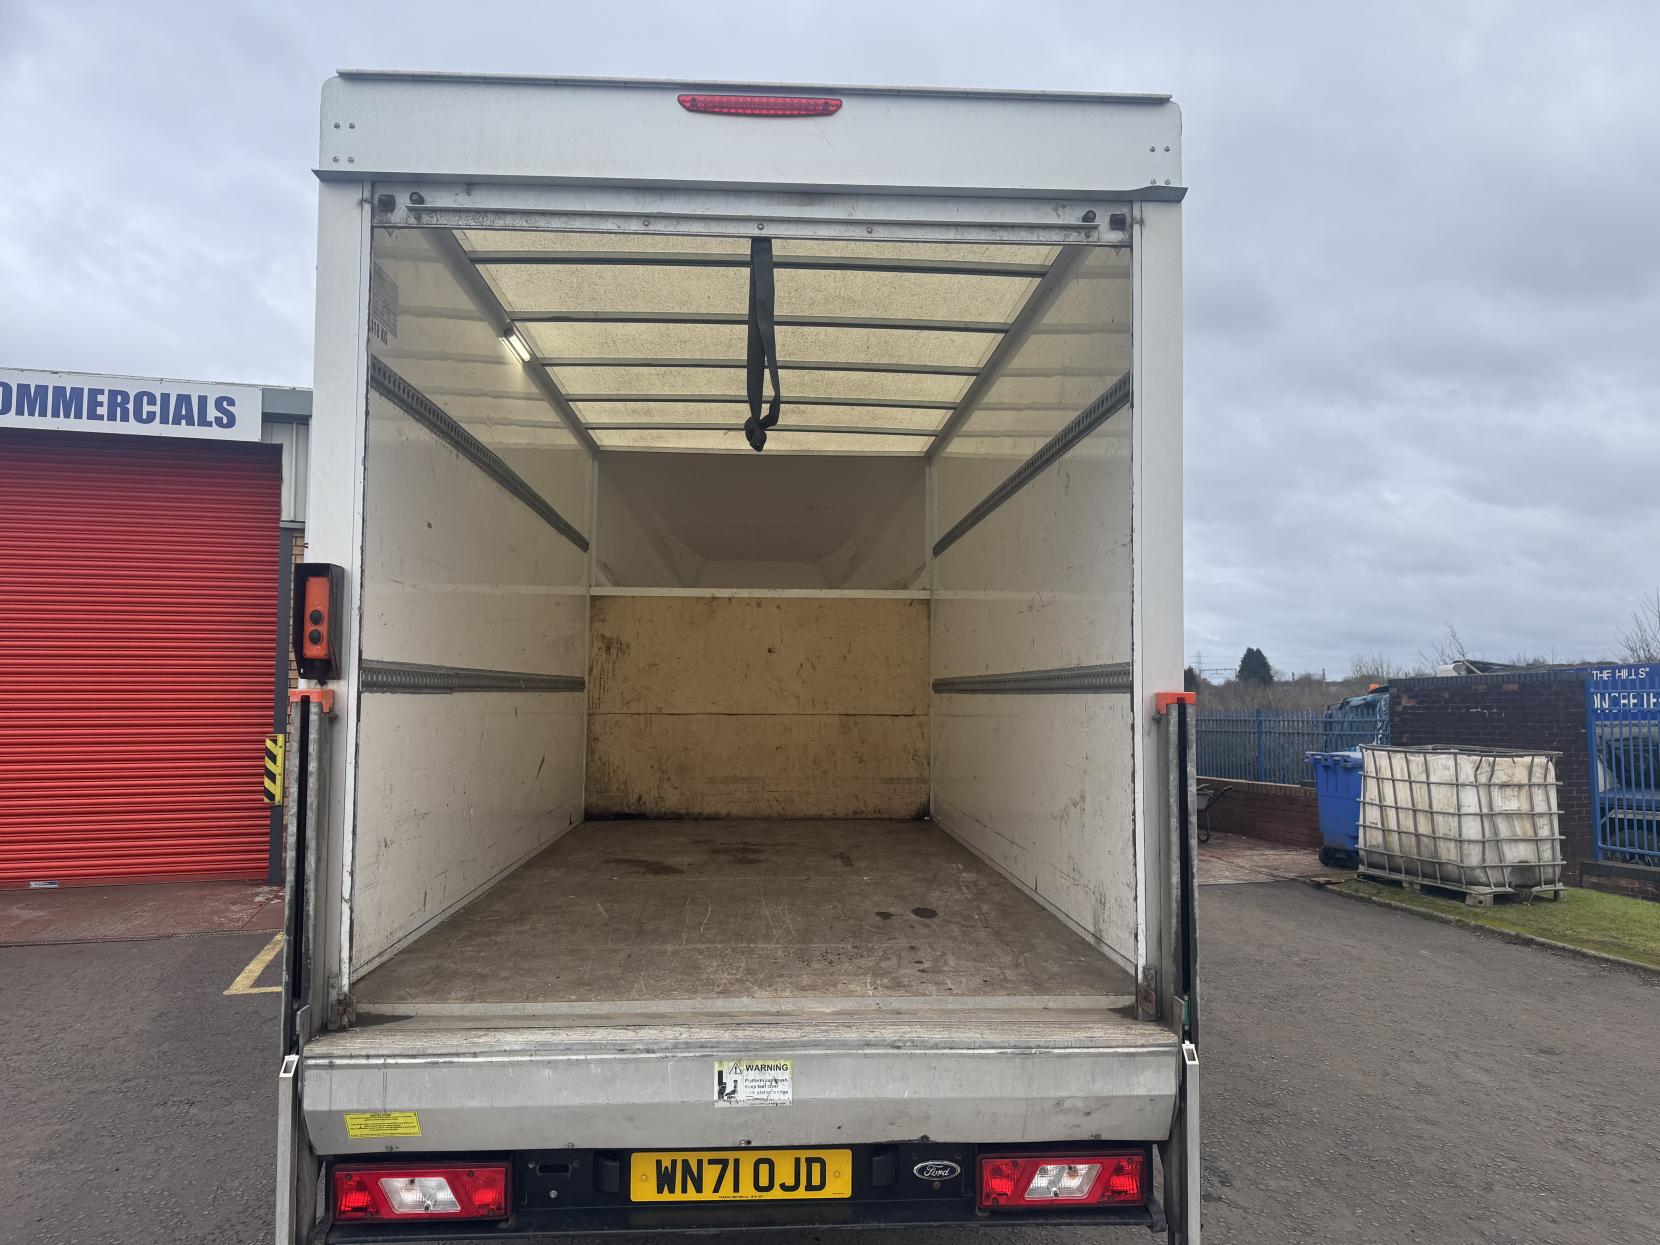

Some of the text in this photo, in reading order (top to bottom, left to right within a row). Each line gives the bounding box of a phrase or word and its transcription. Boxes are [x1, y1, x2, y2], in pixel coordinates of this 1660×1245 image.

[1592, 670, 1612, 681] THE
[745, 1063, 789, 1072] WARNING
[655, 1156, 827, 1195] WN71 OJD
[923, 1164, 951, 1177] Ford
